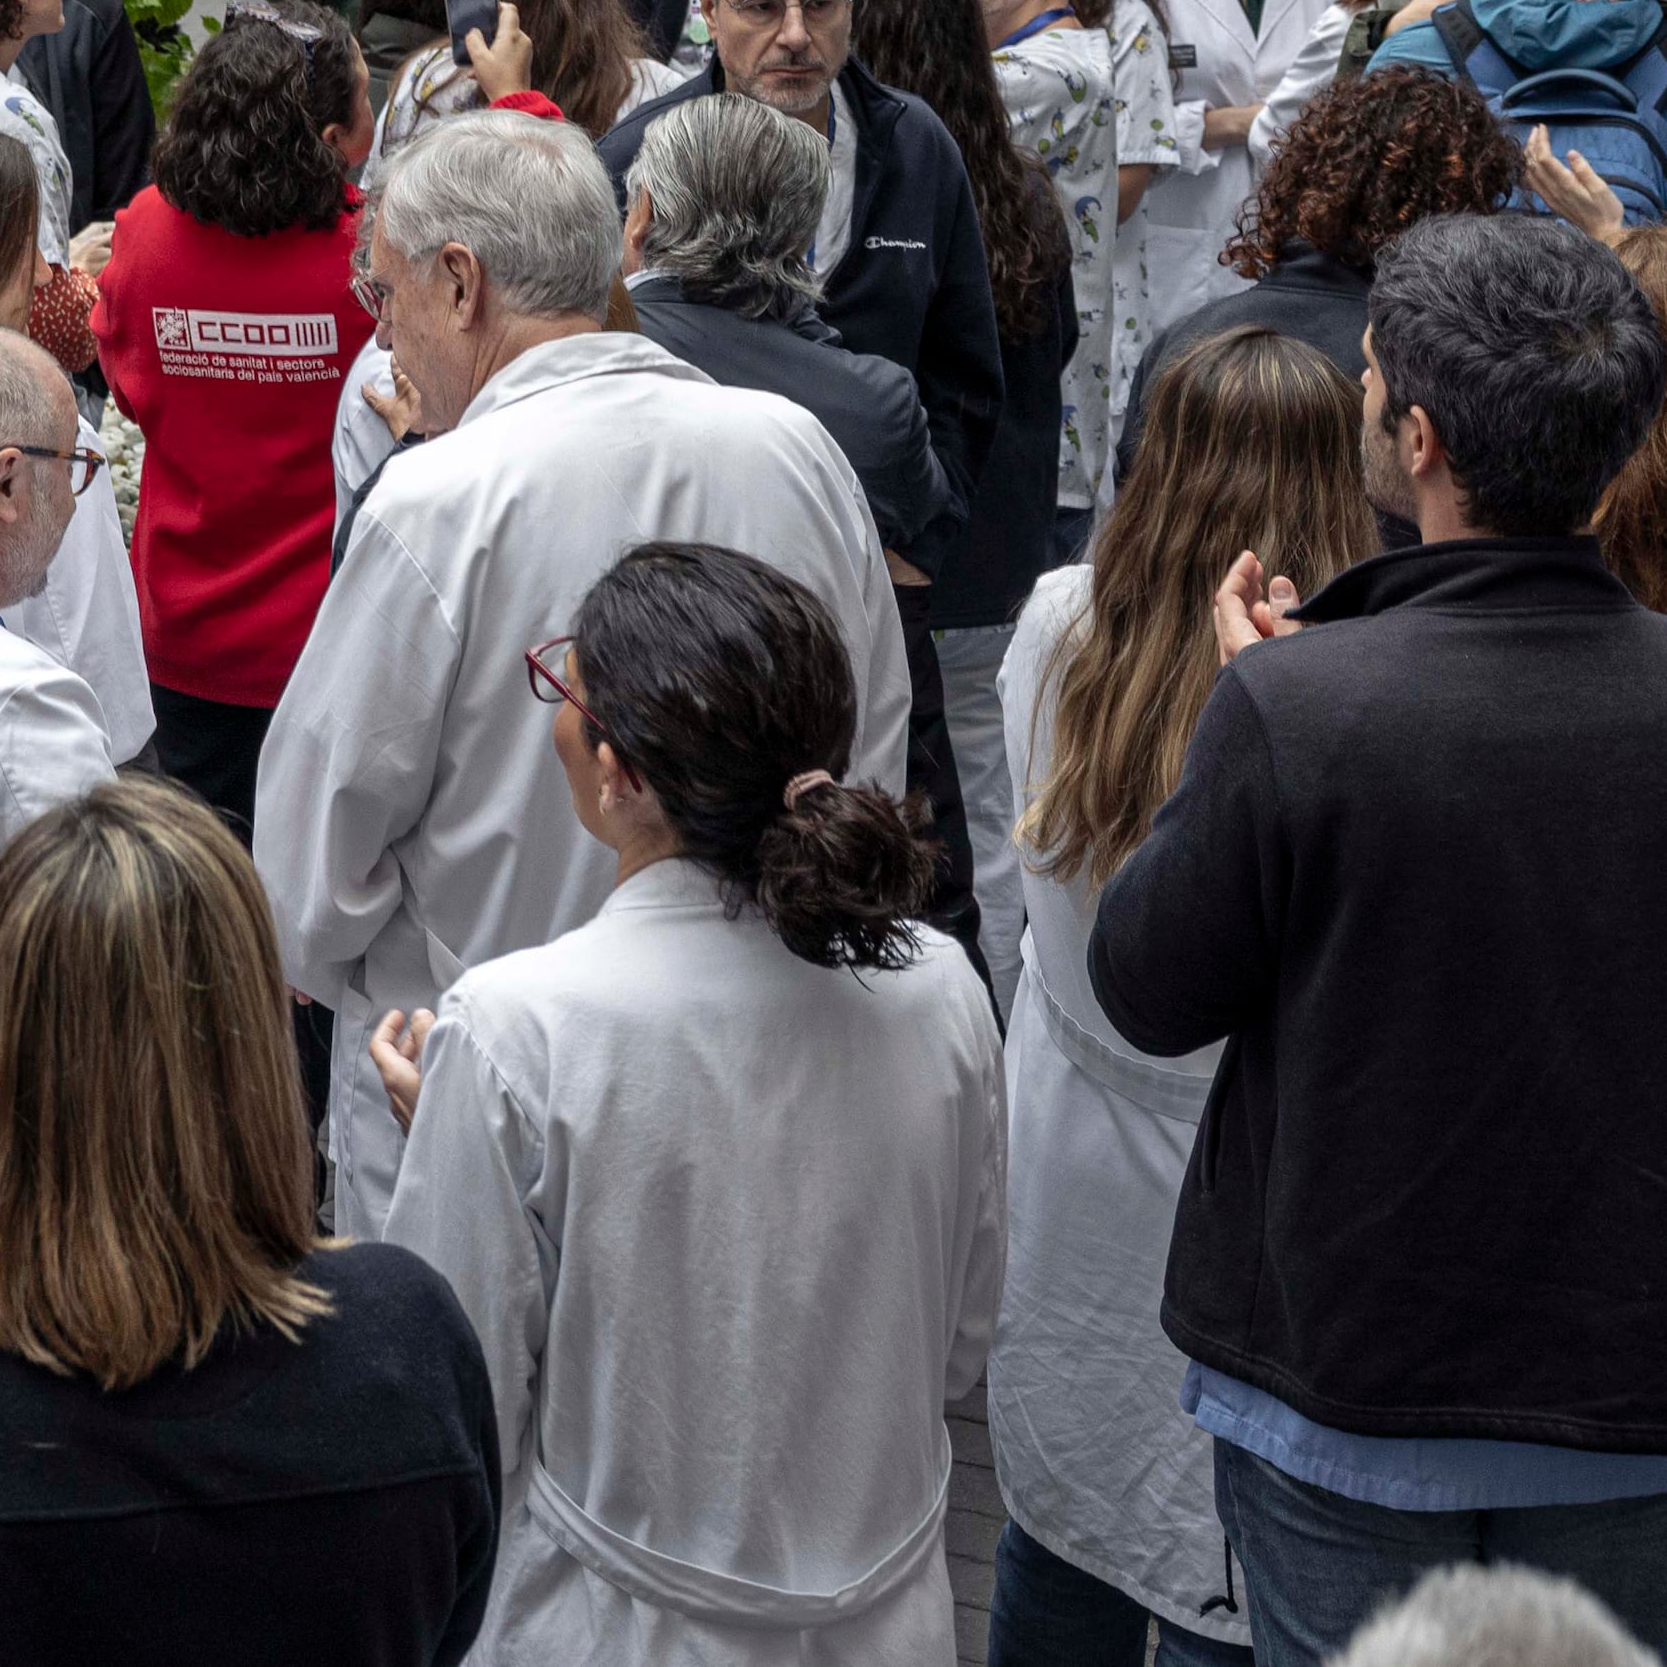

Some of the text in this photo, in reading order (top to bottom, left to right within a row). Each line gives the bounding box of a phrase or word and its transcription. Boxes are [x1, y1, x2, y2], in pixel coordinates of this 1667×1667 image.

[866, 235, 926, 252] Champion
[197, 321, 291, 345] CCOO
[160, 351, 208, 366] federació
[212, 355, 227, 367] de
[229, 356, 267, 370] sanitat
[277, 358, 324, 371] sectors
[162, 364, 235, 380] sociosanitaris
[237, 368, 255, 381] del
